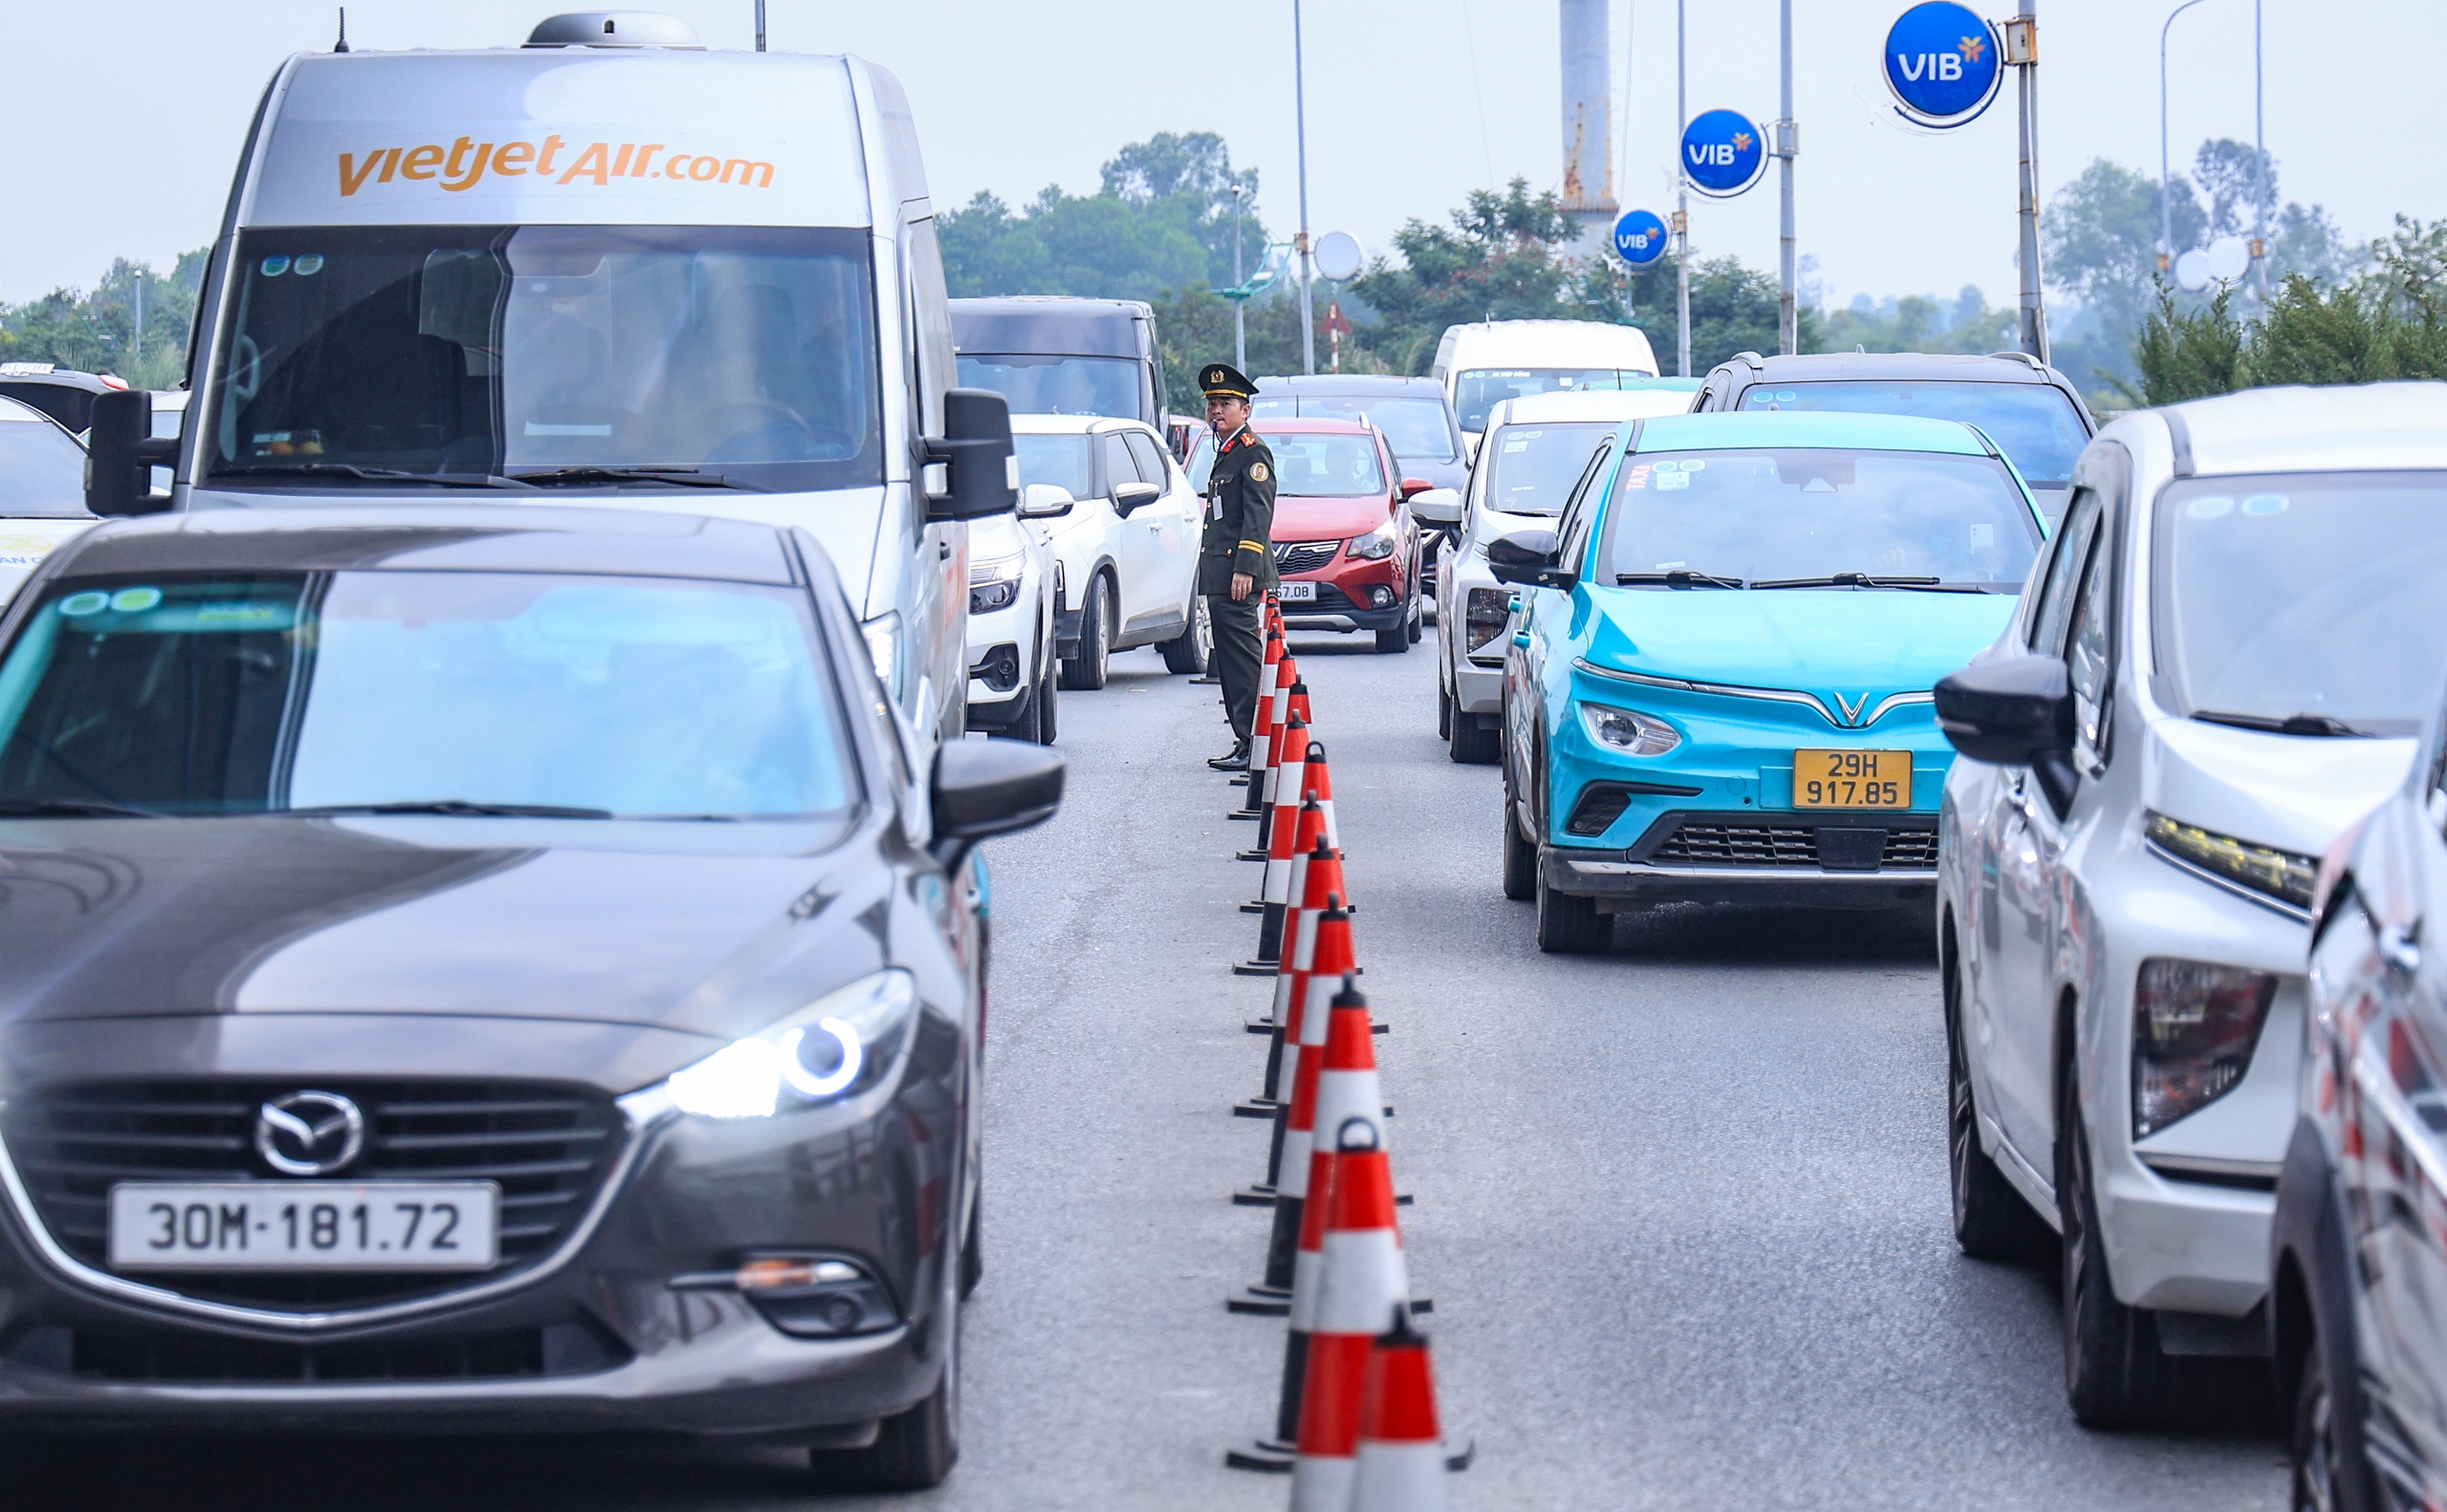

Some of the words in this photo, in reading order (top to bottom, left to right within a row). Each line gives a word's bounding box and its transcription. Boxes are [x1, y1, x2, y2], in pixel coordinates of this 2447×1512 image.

[1897, 53, 1963, 81] VIB
[1688, 143, 1736, 165] VIB
[1617, 233, 1649, 249] VIB
[1626, 465, 1651, 490] TAXI
[1828, 753, 1878, 777] 29H
[1807, 780, 1898, 805] 917.85
[148, 1202, 461, 1251] 30M-181.72
